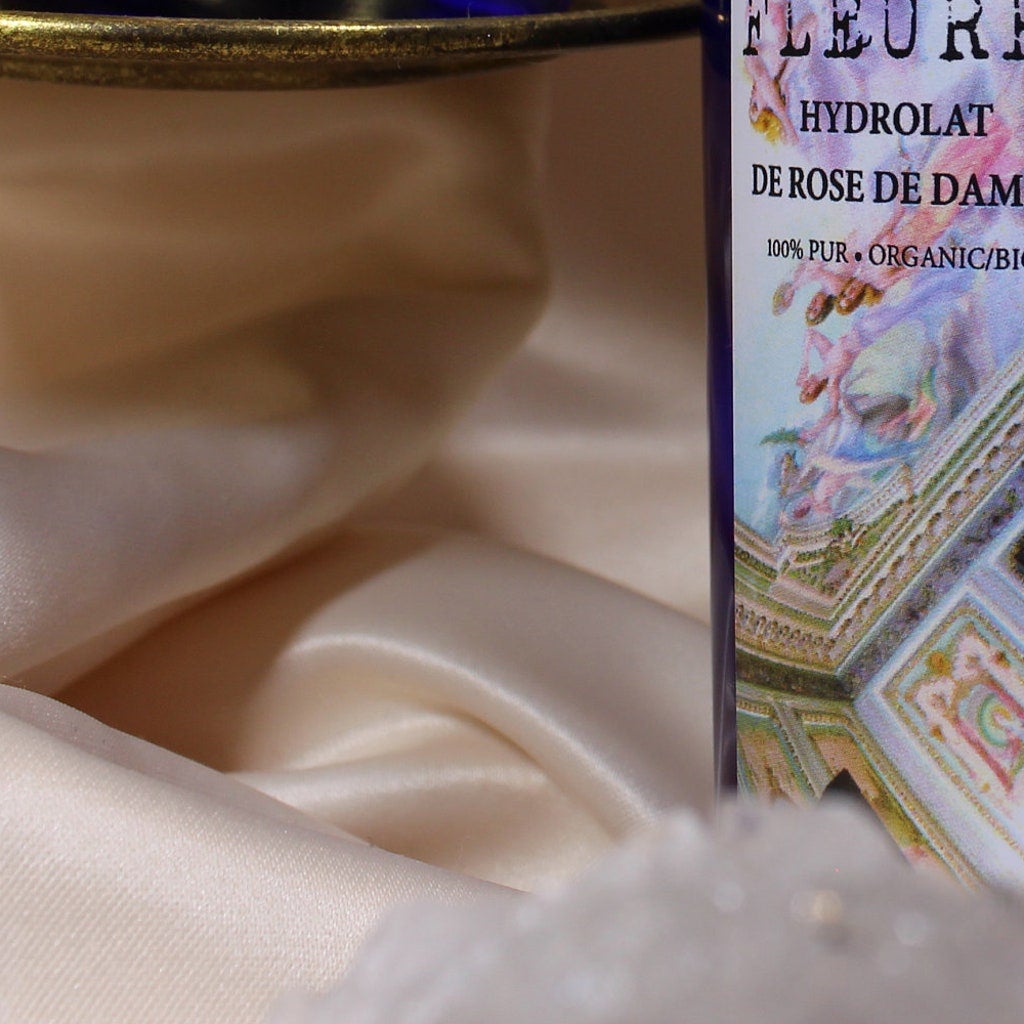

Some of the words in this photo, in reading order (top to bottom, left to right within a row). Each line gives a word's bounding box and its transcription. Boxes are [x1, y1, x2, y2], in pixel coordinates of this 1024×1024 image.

[800, 100, 993, 137] HYDROLAT
[752, 163, 783, 198] DE
[788, 166, 864, 203] ROSE
[873, 171, 922, 205] DE
[767, 238, 803, 260] 100%
[809, 240, 849, 263] PUR
